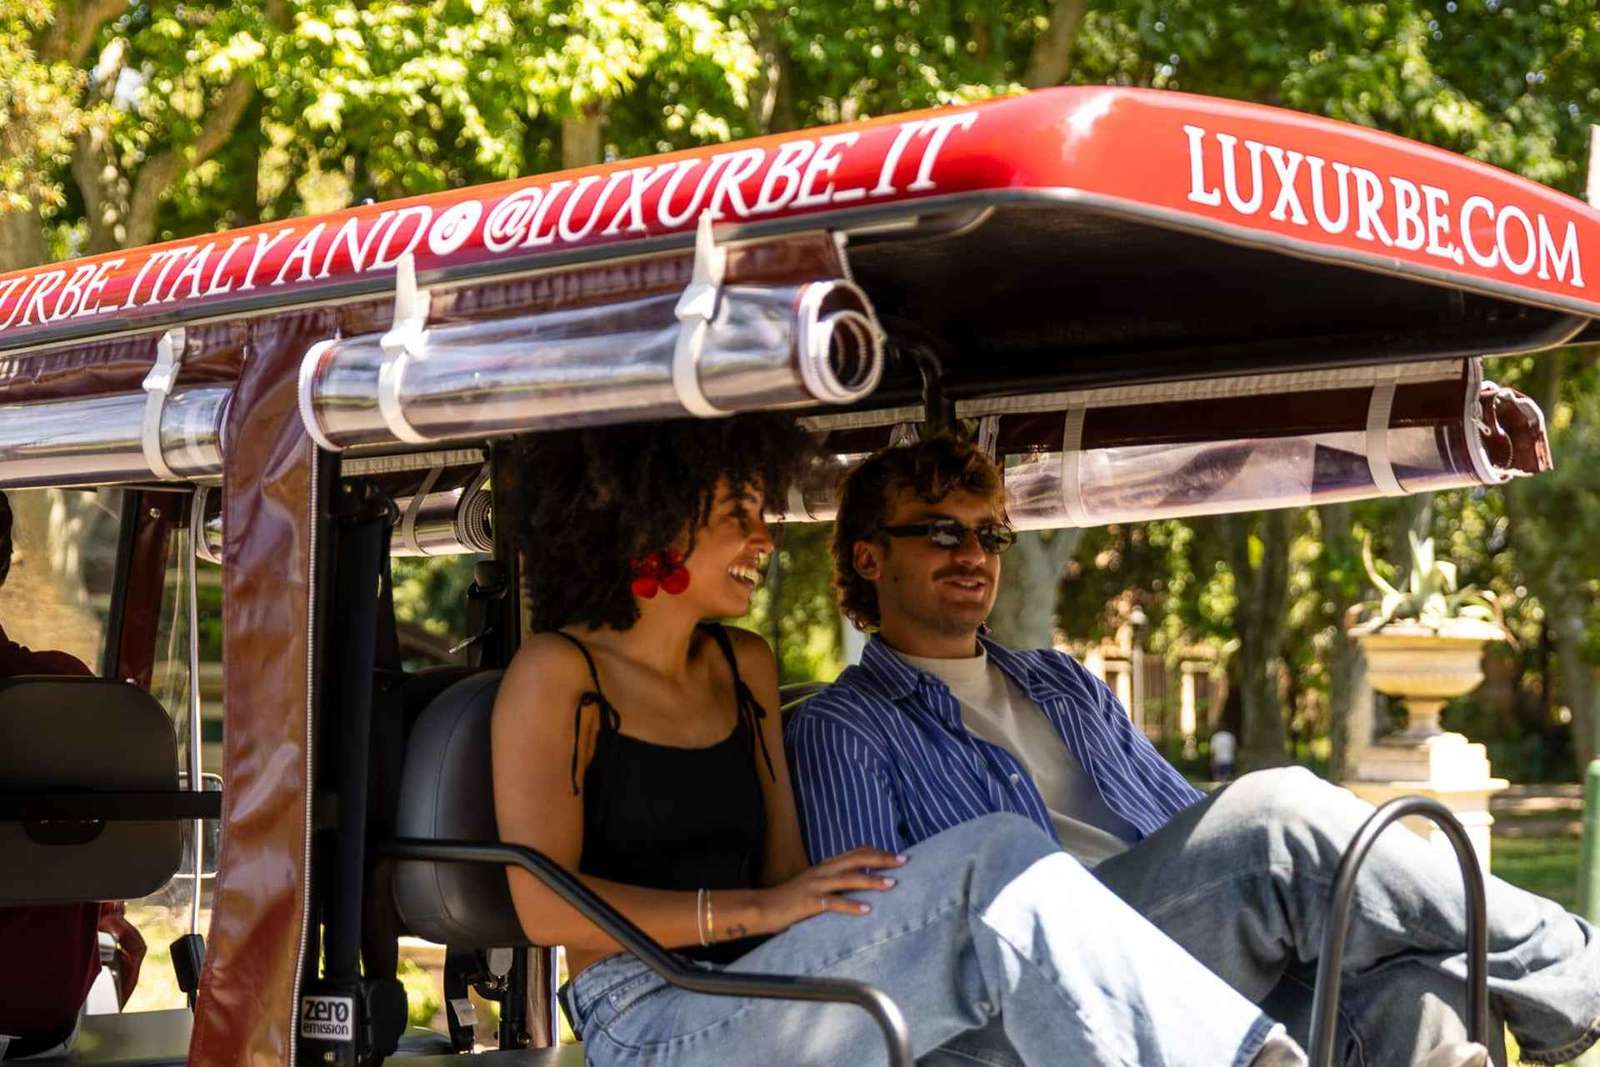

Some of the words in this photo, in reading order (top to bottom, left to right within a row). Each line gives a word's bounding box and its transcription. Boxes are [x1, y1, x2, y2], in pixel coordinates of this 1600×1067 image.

[271, 205, 433, 286] AND
[483, 111, 977, 252] @LUXURBE_IT
[1184, 125, 1585, 288] LUXURBE.COM
[303, 1022, 349, 1036] emission
[304, 1000, 349, 1023] zero
